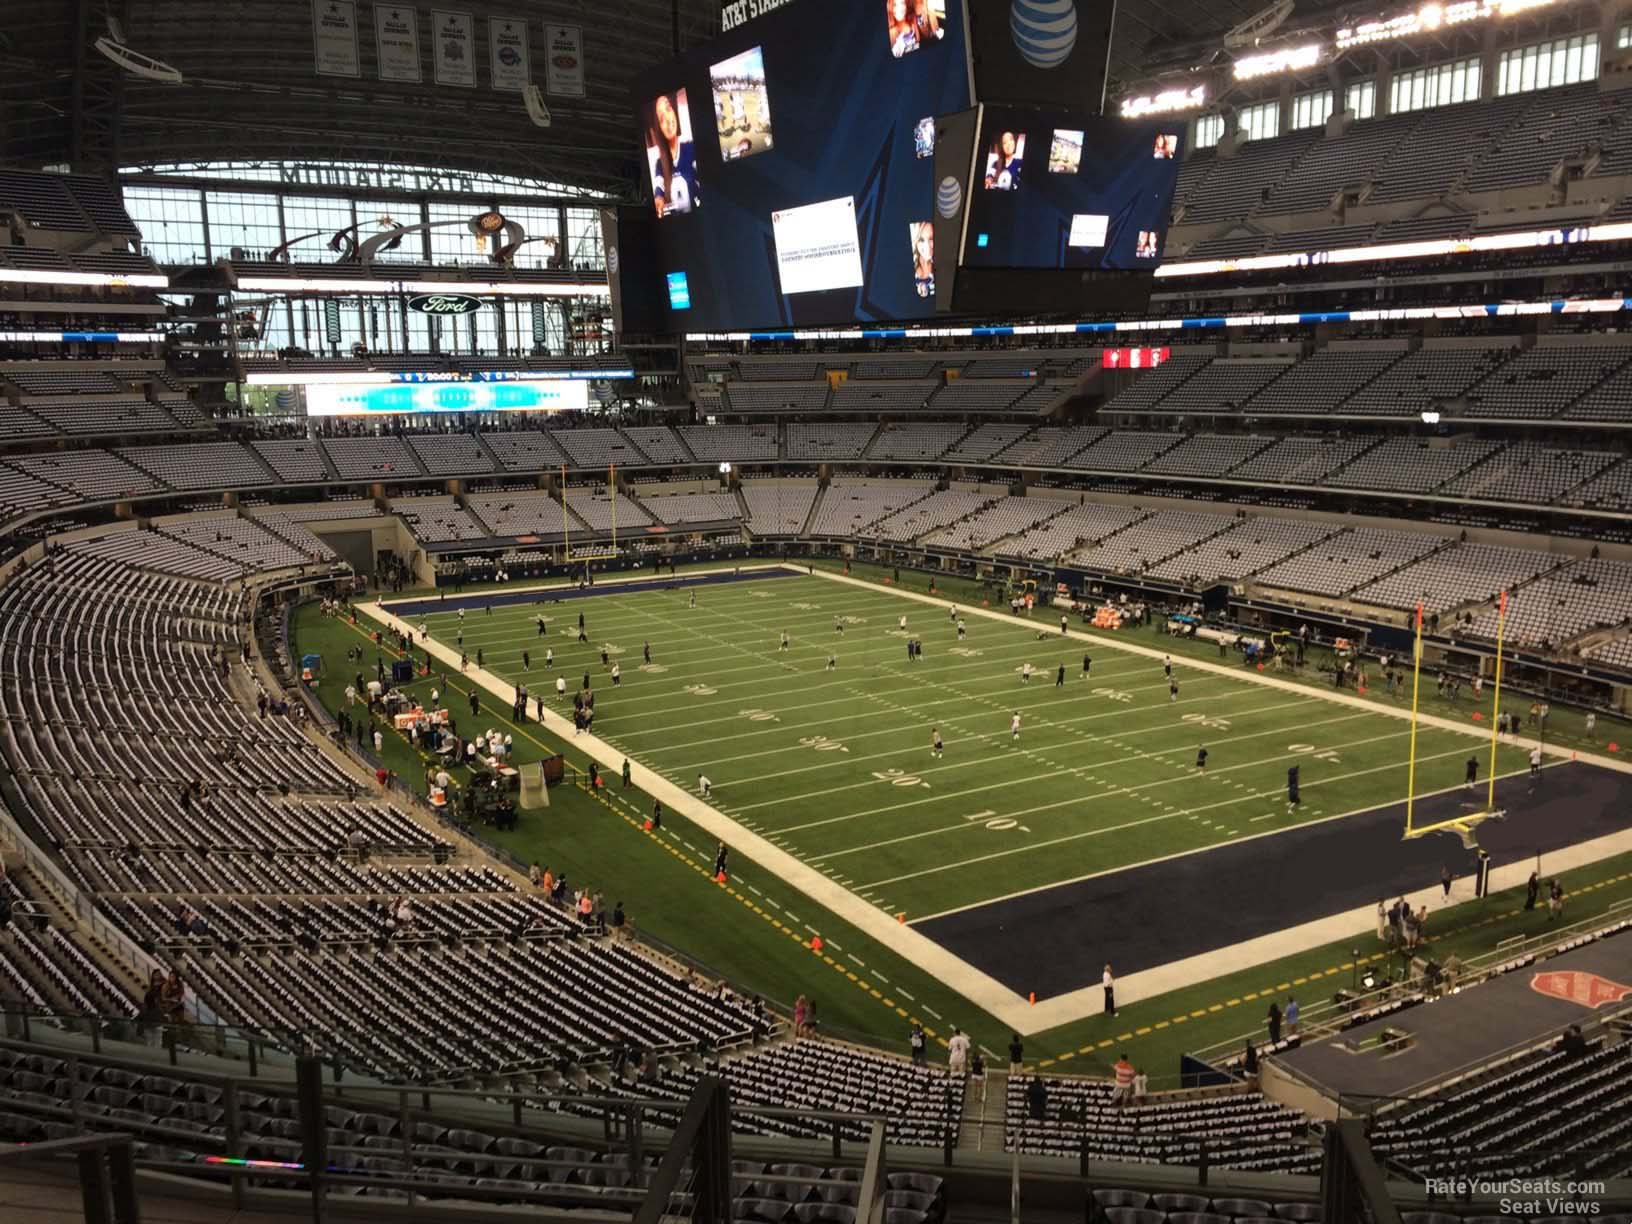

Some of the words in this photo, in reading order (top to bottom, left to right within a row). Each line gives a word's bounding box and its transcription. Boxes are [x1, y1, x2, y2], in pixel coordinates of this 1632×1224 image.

[722, 0, 748, 32] AT&T
[422, 296, 468, 312] Ford
[962, 809, 1018, 830] 10
